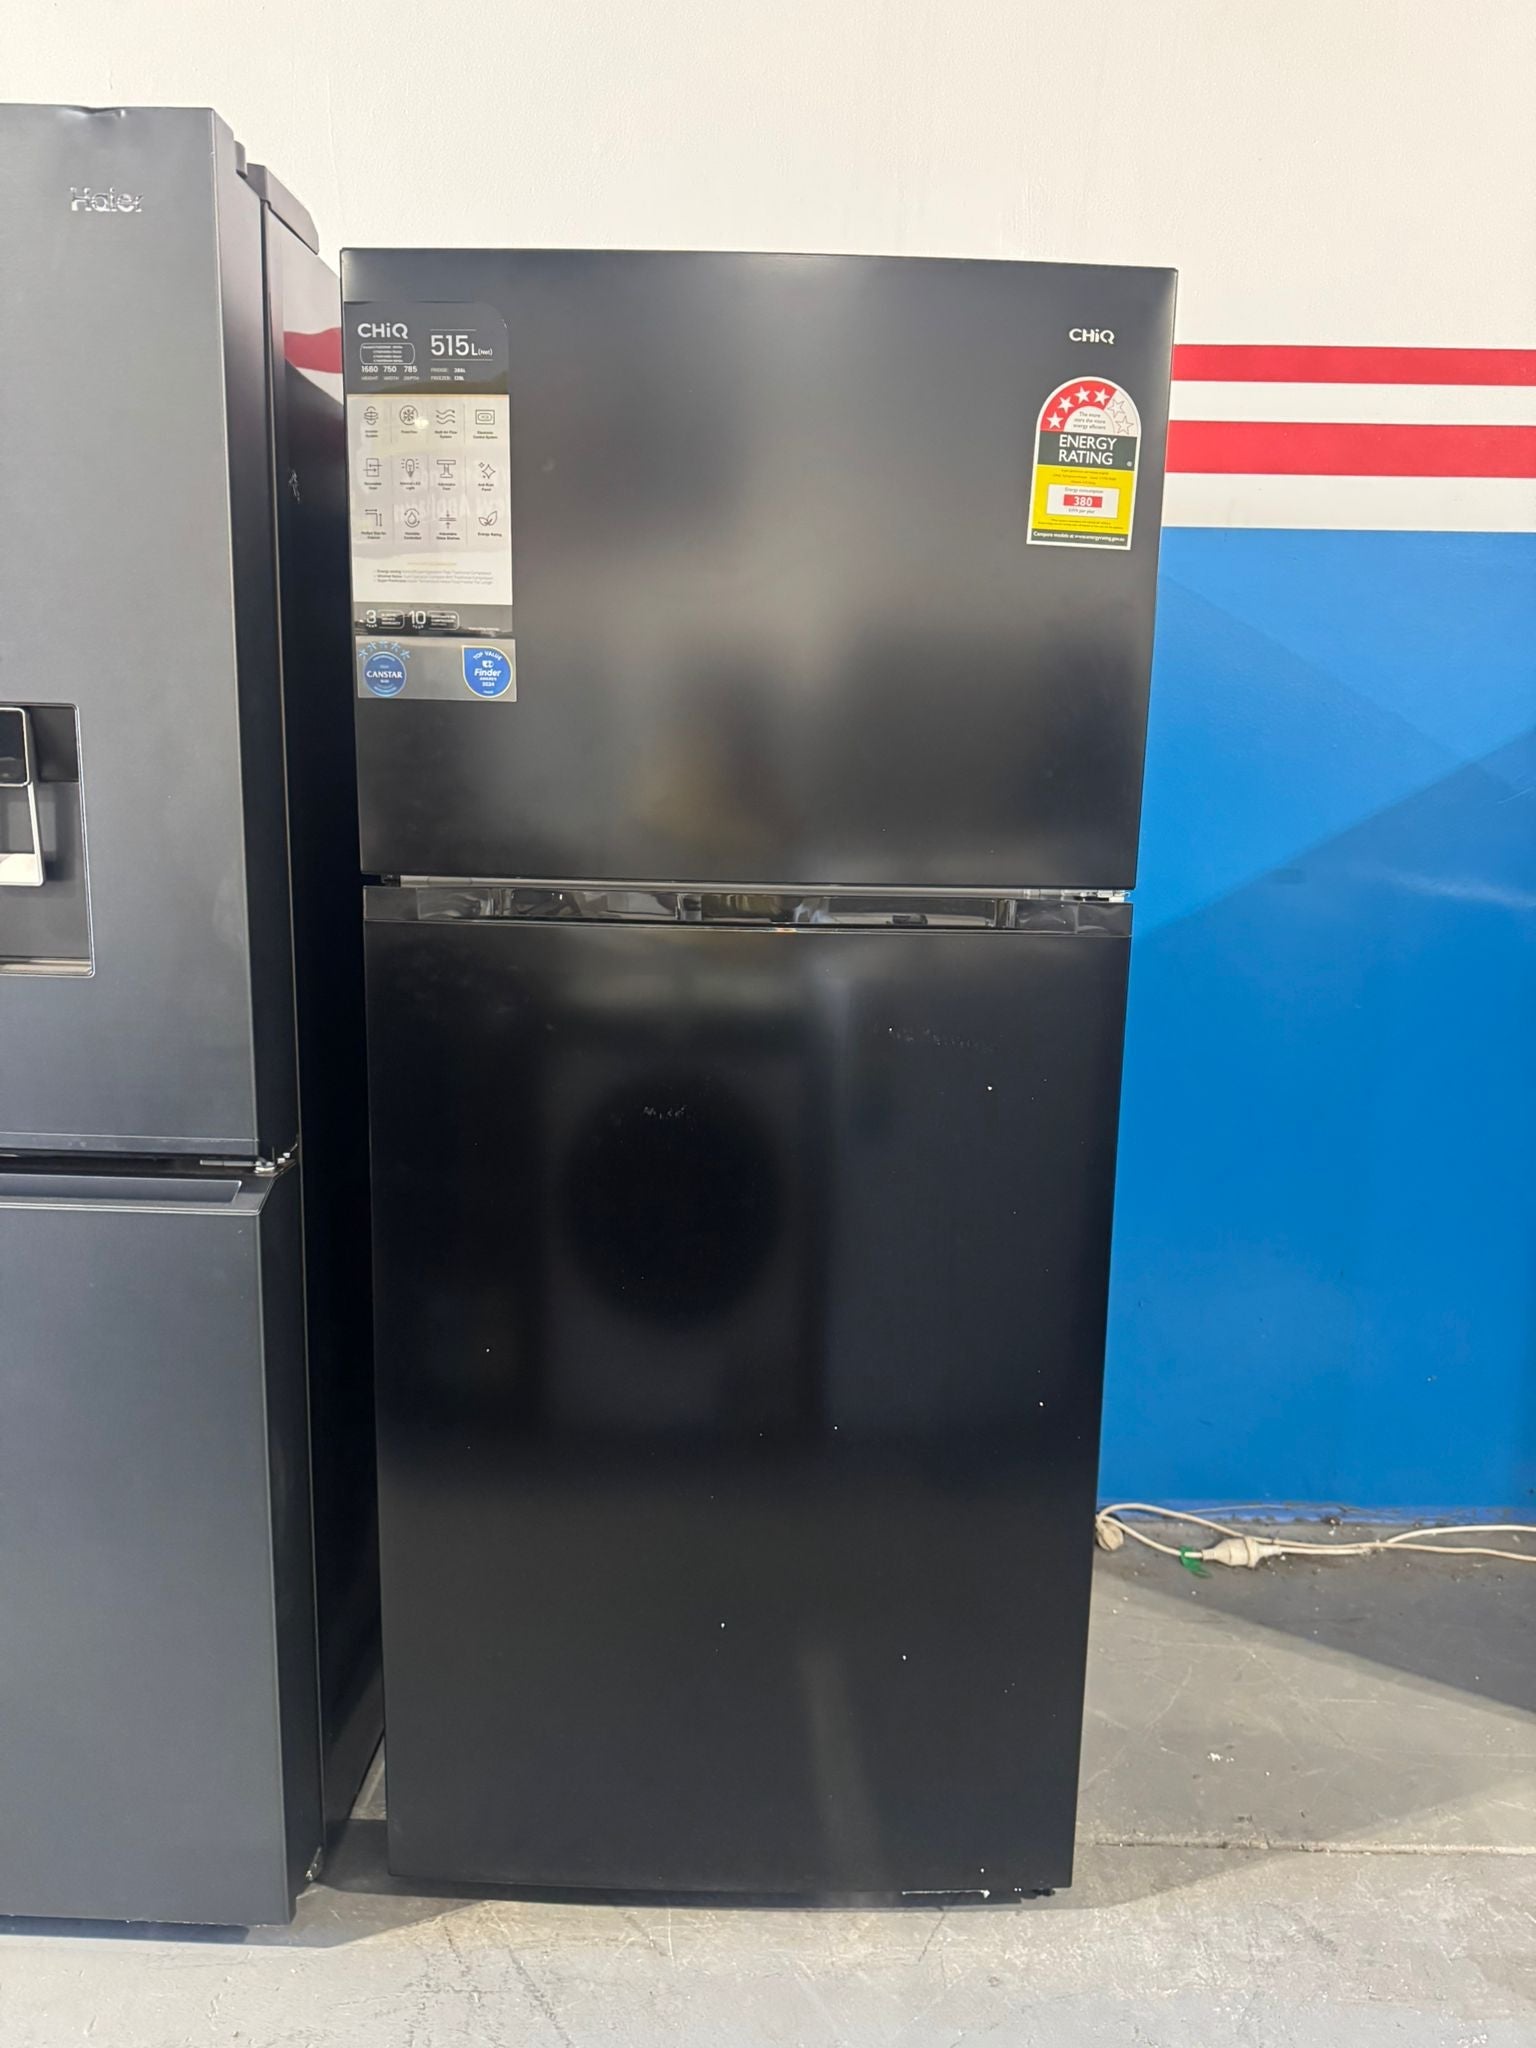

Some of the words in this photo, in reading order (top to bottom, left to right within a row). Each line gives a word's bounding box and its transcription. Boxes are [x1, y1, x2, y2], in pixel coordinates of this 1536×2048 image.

[70, 187, 144, 212] Haier
[357, 322, 408, 340] CHiQ
[1068, 328, 1115, 345] CHiQ
[383, 365, 397, 373] 750
[403, 365, 418, 373] 785
[1059, 434, 1117, 451] ENERGY
[1058, 449, 1113, 465] RATING
[1074, 496, 1093, 507] 380
[1033, 530, 1053, 538] Compare
[366, 609, 376, 624] 3
[408, 610, 426, 624] 10
[473, 651, 483, 660] TOP
[484, 650, 502, 661] VALUE
[366, 670, 403, 679] CANSTAR
[474, 668, 502, 677] Finder
